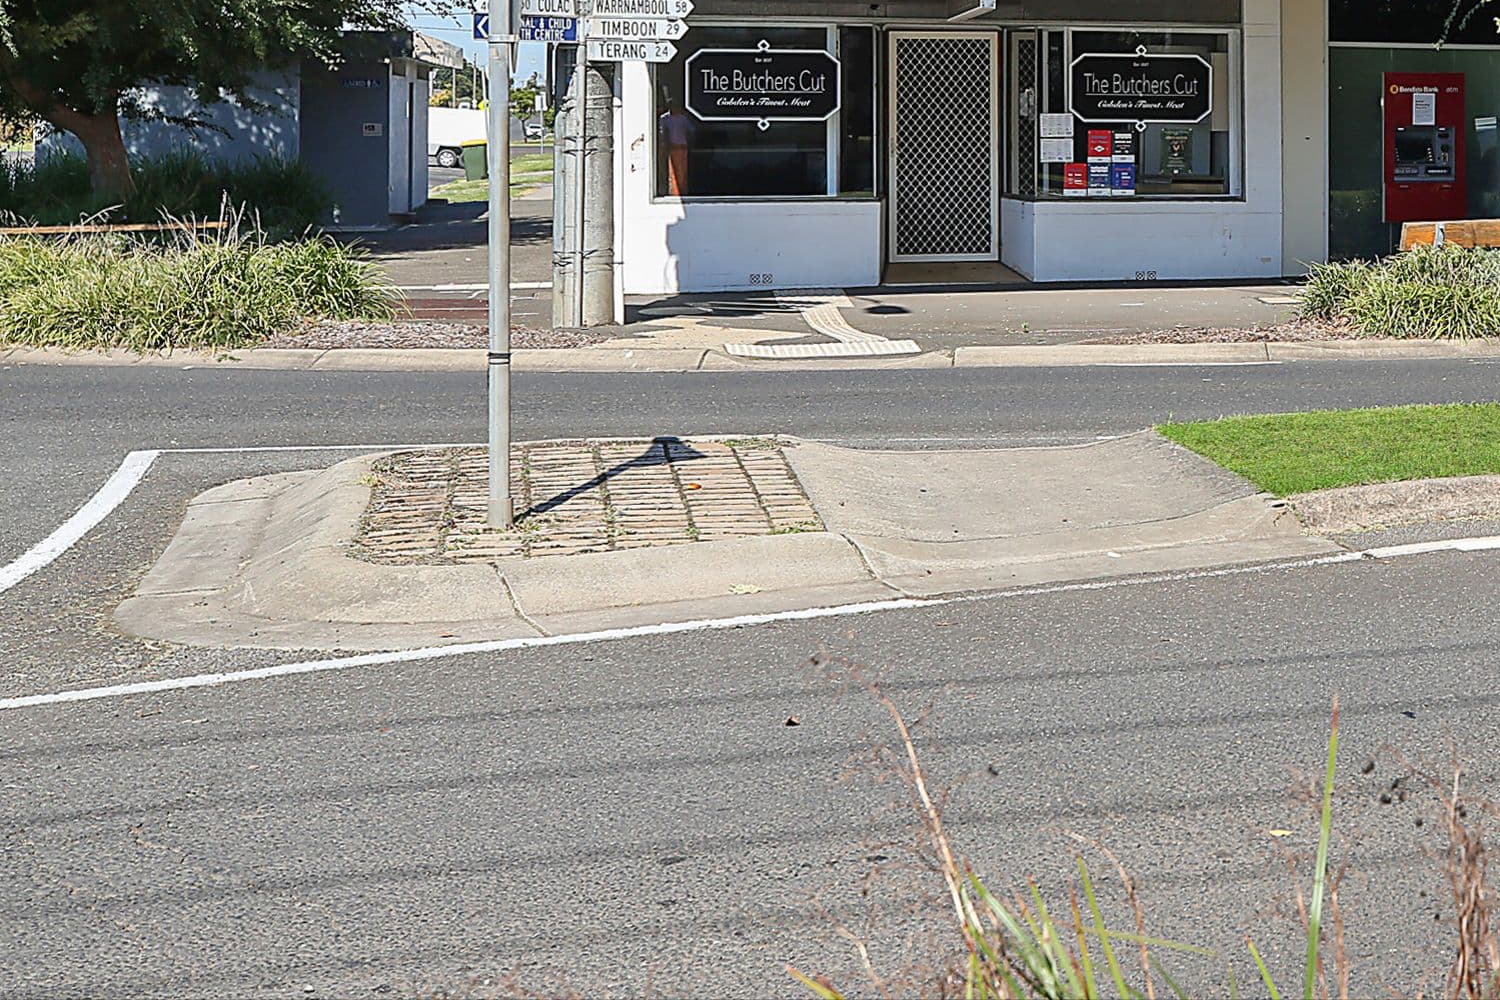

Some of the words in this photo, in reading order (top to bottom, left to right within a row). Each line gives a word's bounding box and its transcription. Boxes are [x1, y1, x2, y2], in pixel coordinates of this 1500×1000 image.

[596, 0, 670, 15] WARRNAMBOOL
[675, 2, 687, 13] 58
[548, 18, 572, 30] CHILD
[601, 20, 657, 36] TIMBOON
[666, 23, 680, 35] 29
[534, 29, 565, 41] CENTRE
[600, 42, 647, 59] TERANG
[655, 46, 669, 57] 24
[701, 69, 729, 91] The
[733, 69, 796, 91] Butchers
[799, 69, 826, 91] Cut
[1083, 72, 1110, 94] The
[1113, 73, 1170, 94] Butchers
[1174, 73, 1199, 95] Cut
